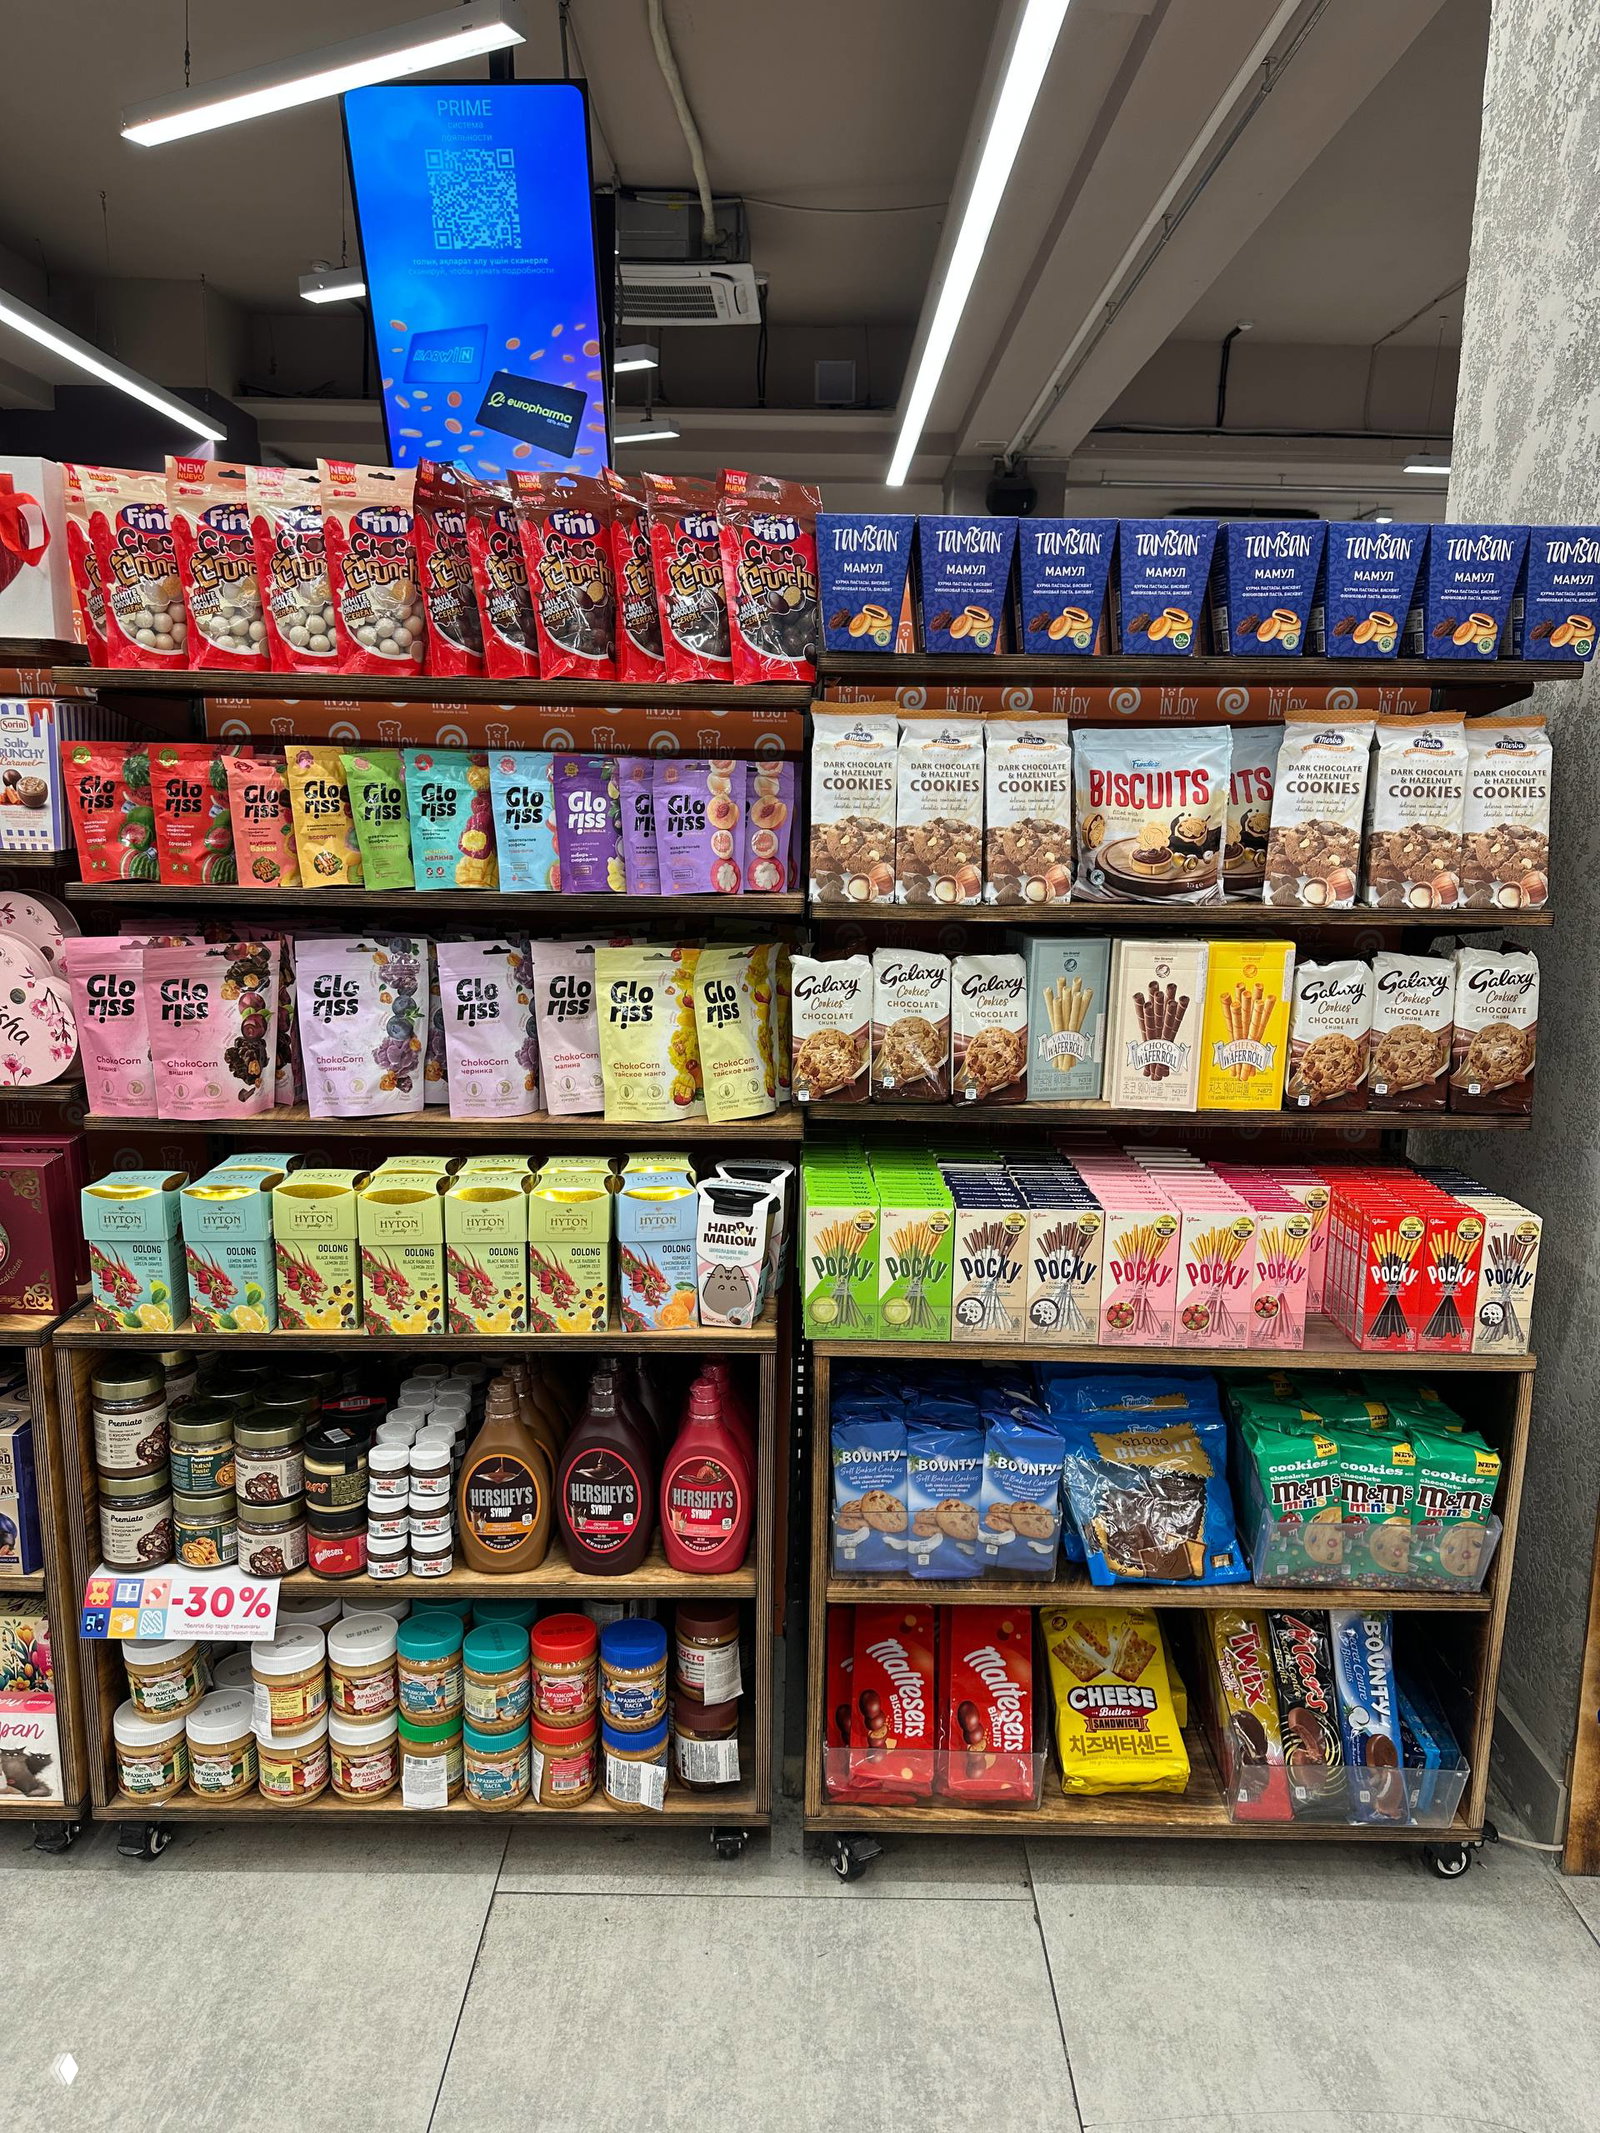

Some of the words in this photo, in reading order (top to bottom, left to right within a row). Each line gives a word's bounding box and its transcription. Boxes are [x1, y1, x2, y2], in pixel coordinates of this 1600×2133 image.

[437, 99, 493, 116] PRIME
[511, 257, 548, 265] сканерле
[508, 398, 572, 423] europharma
[330, 465, 355, 475] NEW
[330, 474, 355, 482] NUEVO
[726, 474, 747, 484] NEW
[725, 484, 747, 492] NUEVO
[361, 509, 409, 534] Fini
[554, 512, 596, 535] Fini
[745, 540, 806, 567] Choco
[844, 563, 883, 574] МАМУЛ
[1255, 569, 1294, 579] МАМУЛ
[1455, 572, 1494, 582] МАМУЛ
[544, 597, 562, 609] MILK
[2, 719, 27, 730] Sorini
[4, 738, 29, 750] Salty
[1415, 739, 1442, 750] Merba
[847, 761, 892, 769] CHOCOLATE
[1391, 768, 1412, 776] DARK
[1415, 769, 1463, 777] CHOCOLATE
[823, 778, 892, 790] COOKIES
[1089, 769, 1210, 809] BISCUITS
[1389, 786, 1462, 798] COOKIES
[1468, 969, 1536, 993] Galaxy
[795, 975, 861, 1001] Galaxy
[1486, 990, 1519, 1004] Cookies
[811, 997, 844, 1011] Cookies
[1475, 1006, 1526, 1015] CHOCOLATE
[1142, 1041, 1173, 1052] CHOCO
[1228, 1041, 1259, 1052] CHEESE
[461, 1059, 509, 1067] ChokoCorn
[553, 1053, 599, 1062] ChokoCorn
[167, 1060, 218, 1069] ChokoCorn
[555, 1062, 581, 1070] малина
[613, 1062, 660, 1070] ChokoCorn
[613, 1070, 643, 1078] тайское
[103, 1215, 142, 1224] HYTON
[708, 1222, 754, 1236] HAPPY
[703, 1233, 757, 1247] MALLOW
[133, 1245, 161, 1254] OOLONG
[318, 1244, 348, 1253] OOLONG
[108, 1419, 142, 1427] Premiato
[1122, 1437, 1169, 1447] choco
[1116, 1440, 1193, 1460] BISCUIT
[841, 1450, 900, 1464] BOUNTY
[840, 1466, 855, 1476] Soft
[856, 1466, 877, 1475] Baked
[878, 1464, 903, 1473] Cookies
[1269, 1459, 1328, 1473] cookies
[1478, 1461, 1499, 1469] NEW
[1270, 1473, 1310, 1481] chocolate
[570, 1483, 634, 1504] HERSHEY'S
[590, 1504, 612, 1516] SYRUP
[1283, 1497, 1326, 1511] minis
[315, 1548, 344, 1565] Maltesers
[172, 1587, 271, 1618] -30%
[678, 1650, 704, 1662] аста
[1363, 1621, 1391, 1718] BOUNTY
[146, 1684, 185, 1700] АРАХИСОВАЯ
[866, 1638, 925, 1738] Maltesers
[155, 1693, 176, 1702] ПАСТА
[617, 1696, 651, 1704] АРАХИСОВАЯ
[1069, 1685, 1157, 1709] CHEESE
[889, 1695, 903, 1734] BISCUITS
[1099, 1707, 1132, 1717] Butter
[1092, 1718, 1142, 1730] SANDWICH
[1069, 1734, 1173, 1756] 치즈버터샌드
